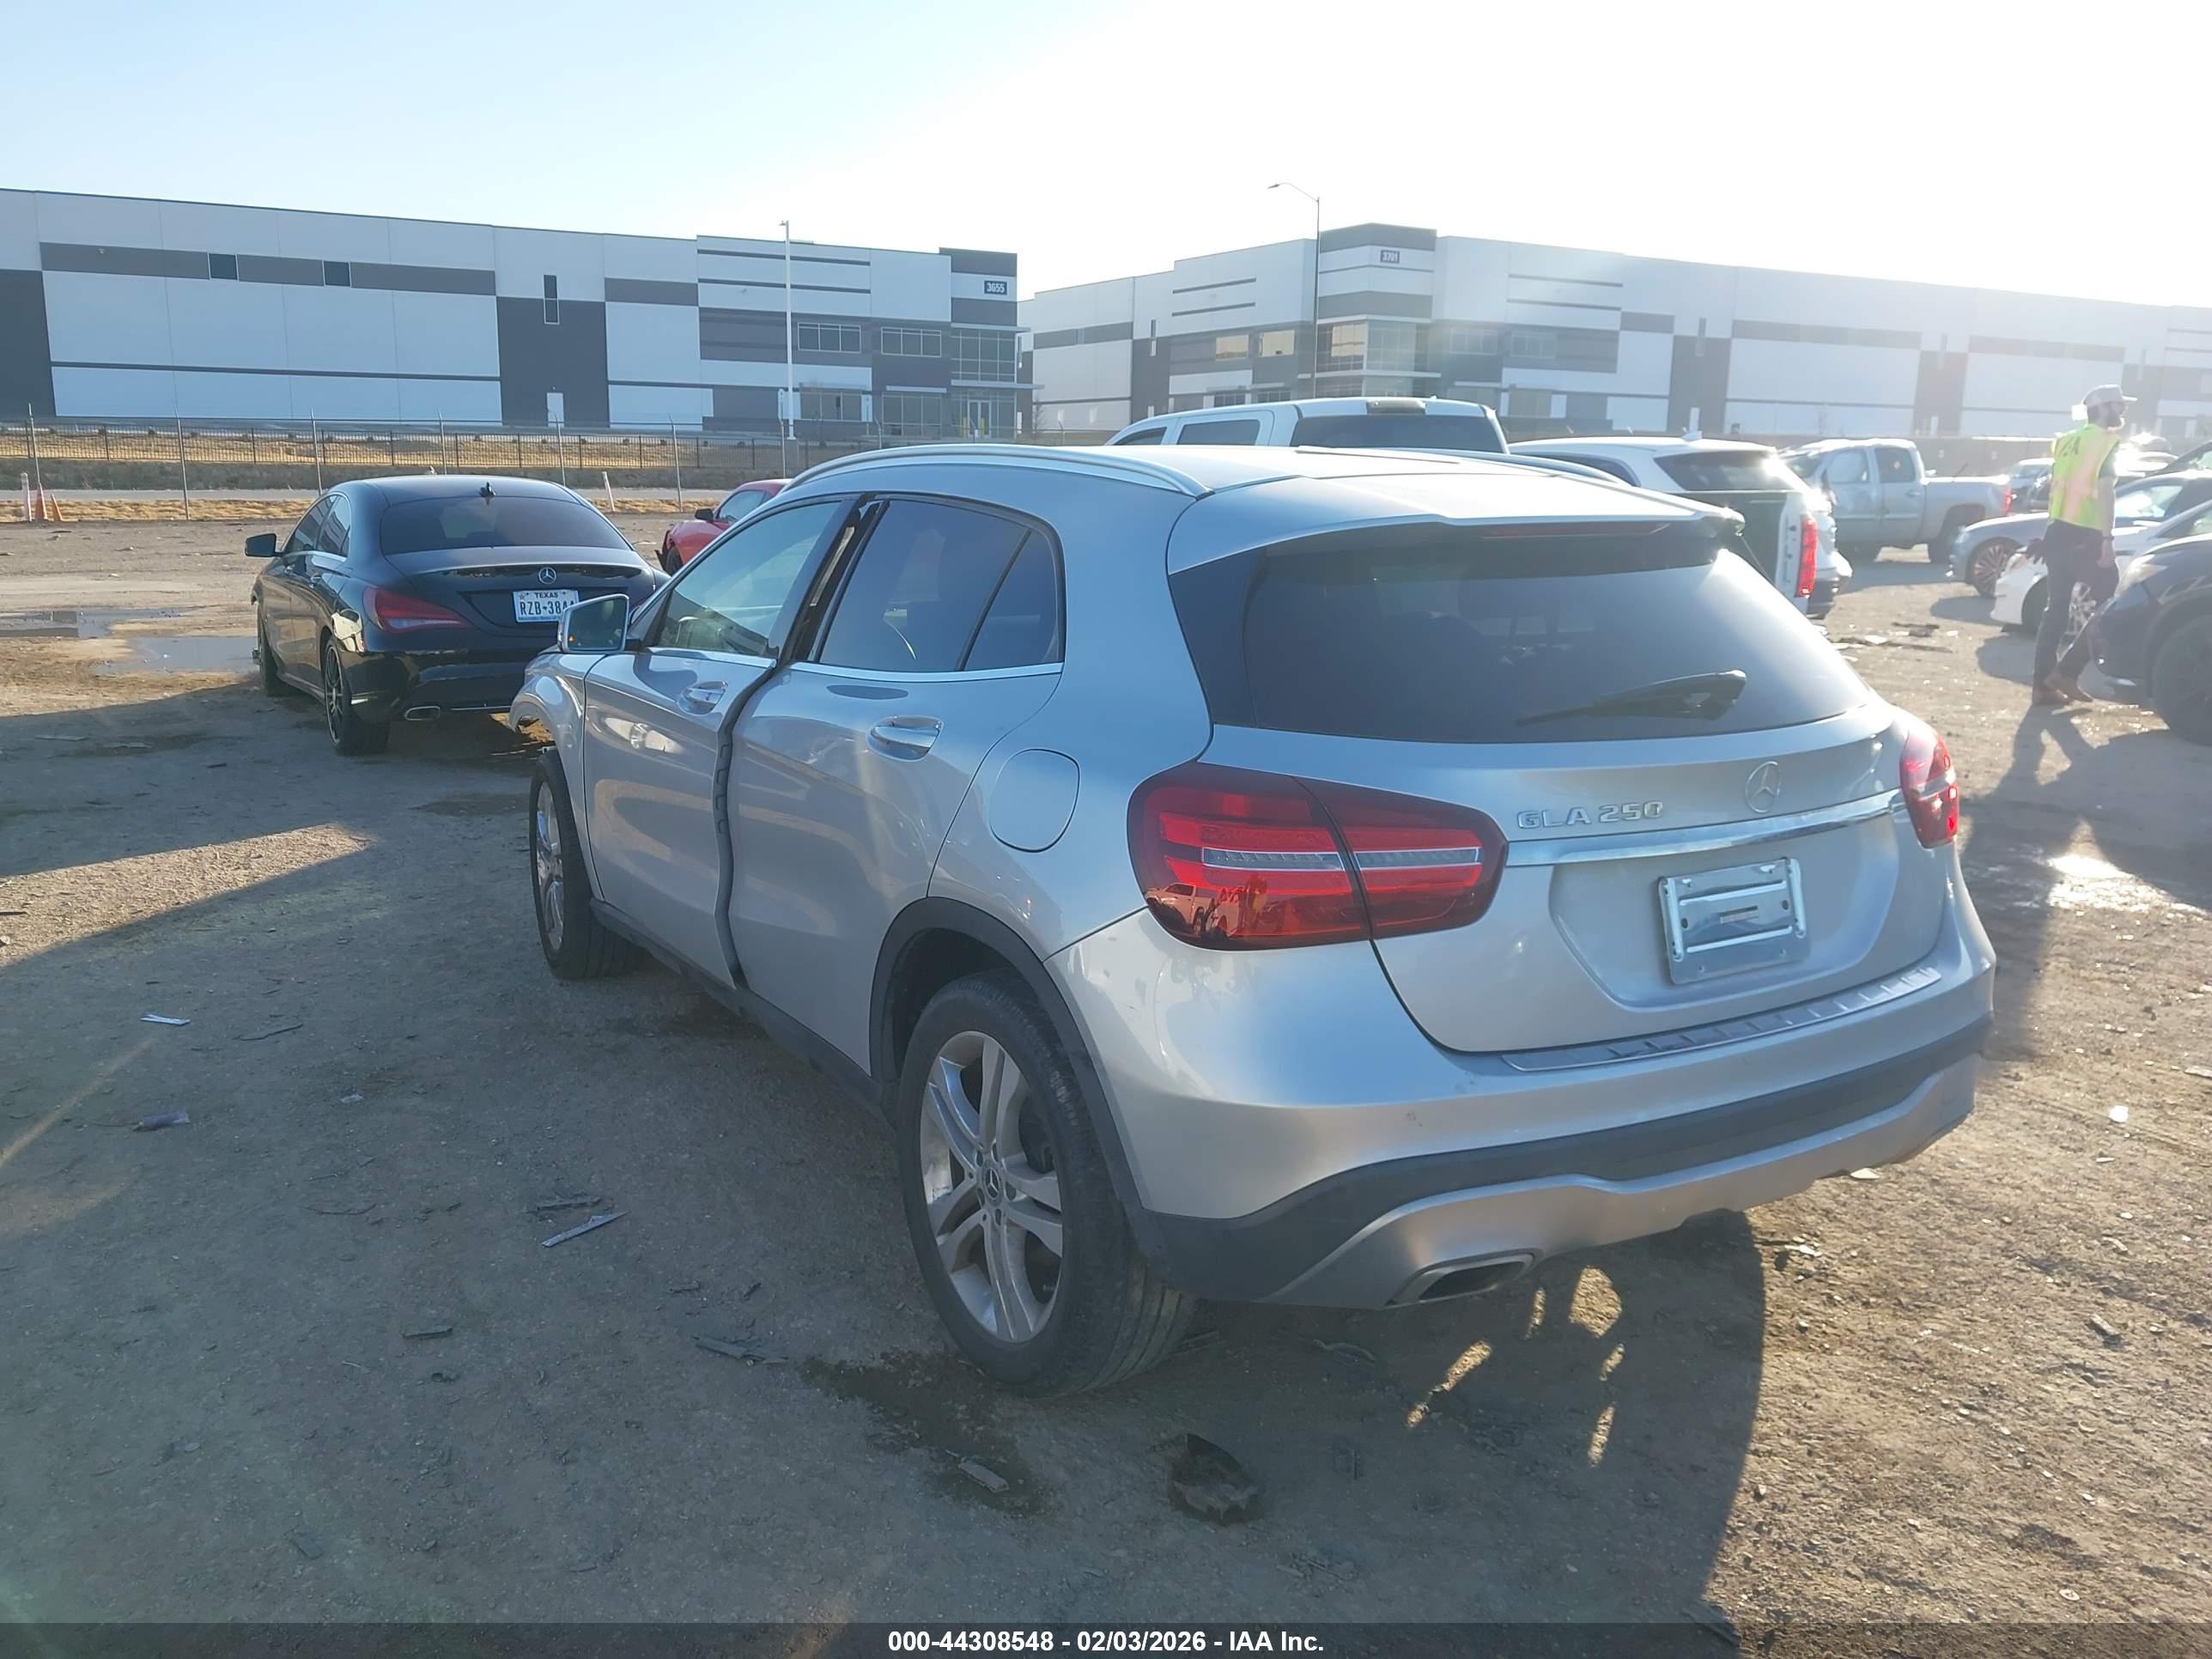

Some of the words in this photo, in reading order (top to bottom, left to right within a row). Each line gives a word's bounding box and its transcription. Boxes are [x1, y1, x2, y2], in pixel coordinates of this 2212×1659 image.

[987, 282, 1006, 294] 3655
[1516, 806, 1592, 830] GLA
[1599, 800, 1663, 823] 250
